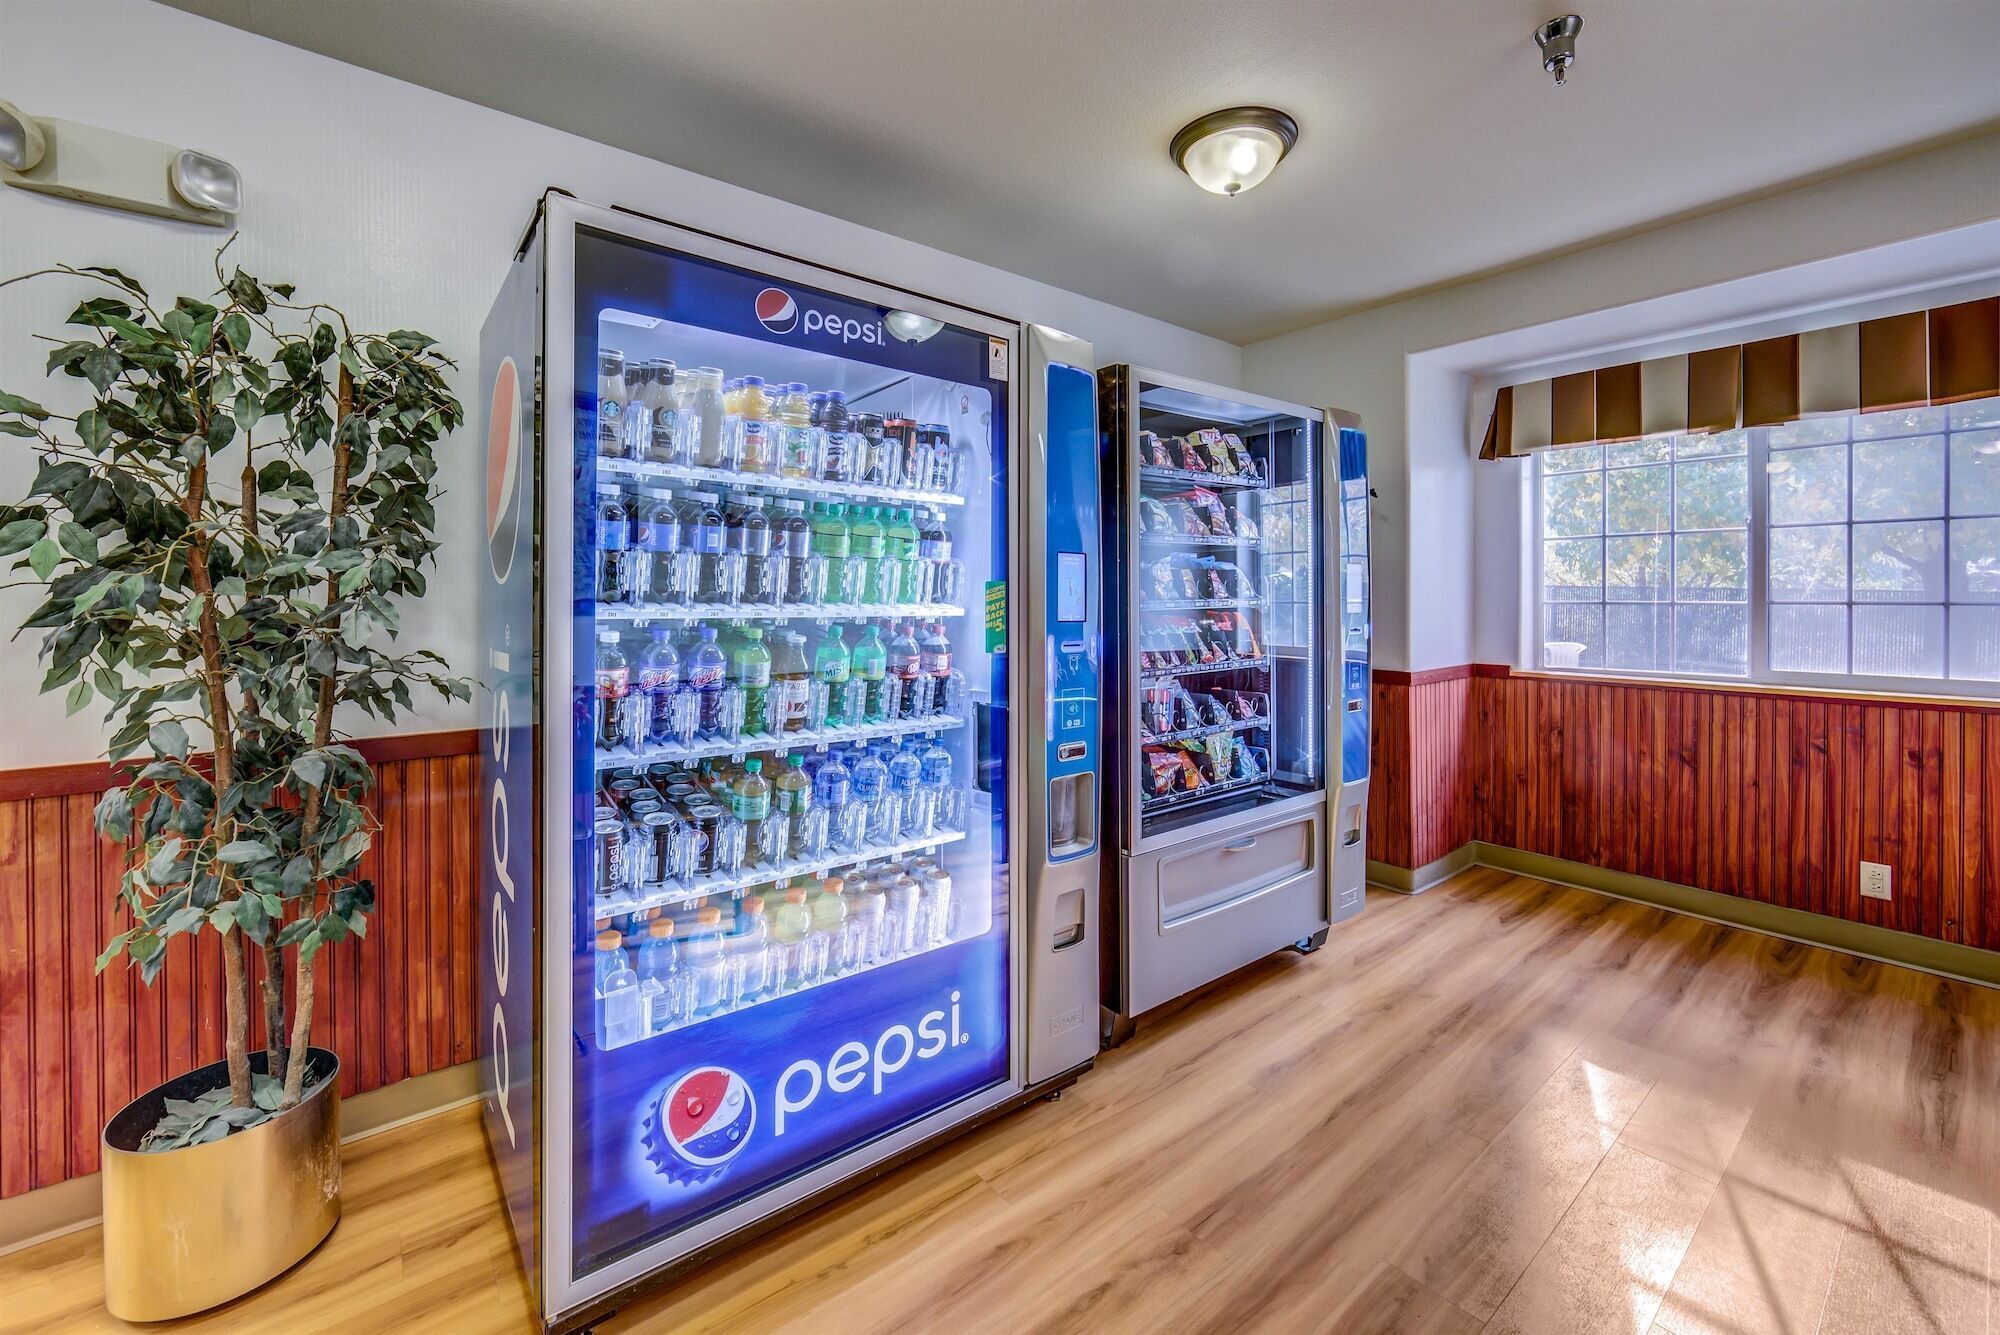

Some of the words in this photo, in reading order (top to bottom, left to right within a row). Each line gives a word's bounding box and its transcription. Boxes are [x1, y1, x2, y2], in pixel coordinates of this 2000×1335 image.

[804, 308, 882, 345] pepsi
[986, 601, 1005, 613] PAYS
[986, 610, 1005, 621] BACK
[825, 663, 847, 678] MIST
[489, 647, 516, 1150] pepsi
[774, 990, 961, 1136] pepsi
